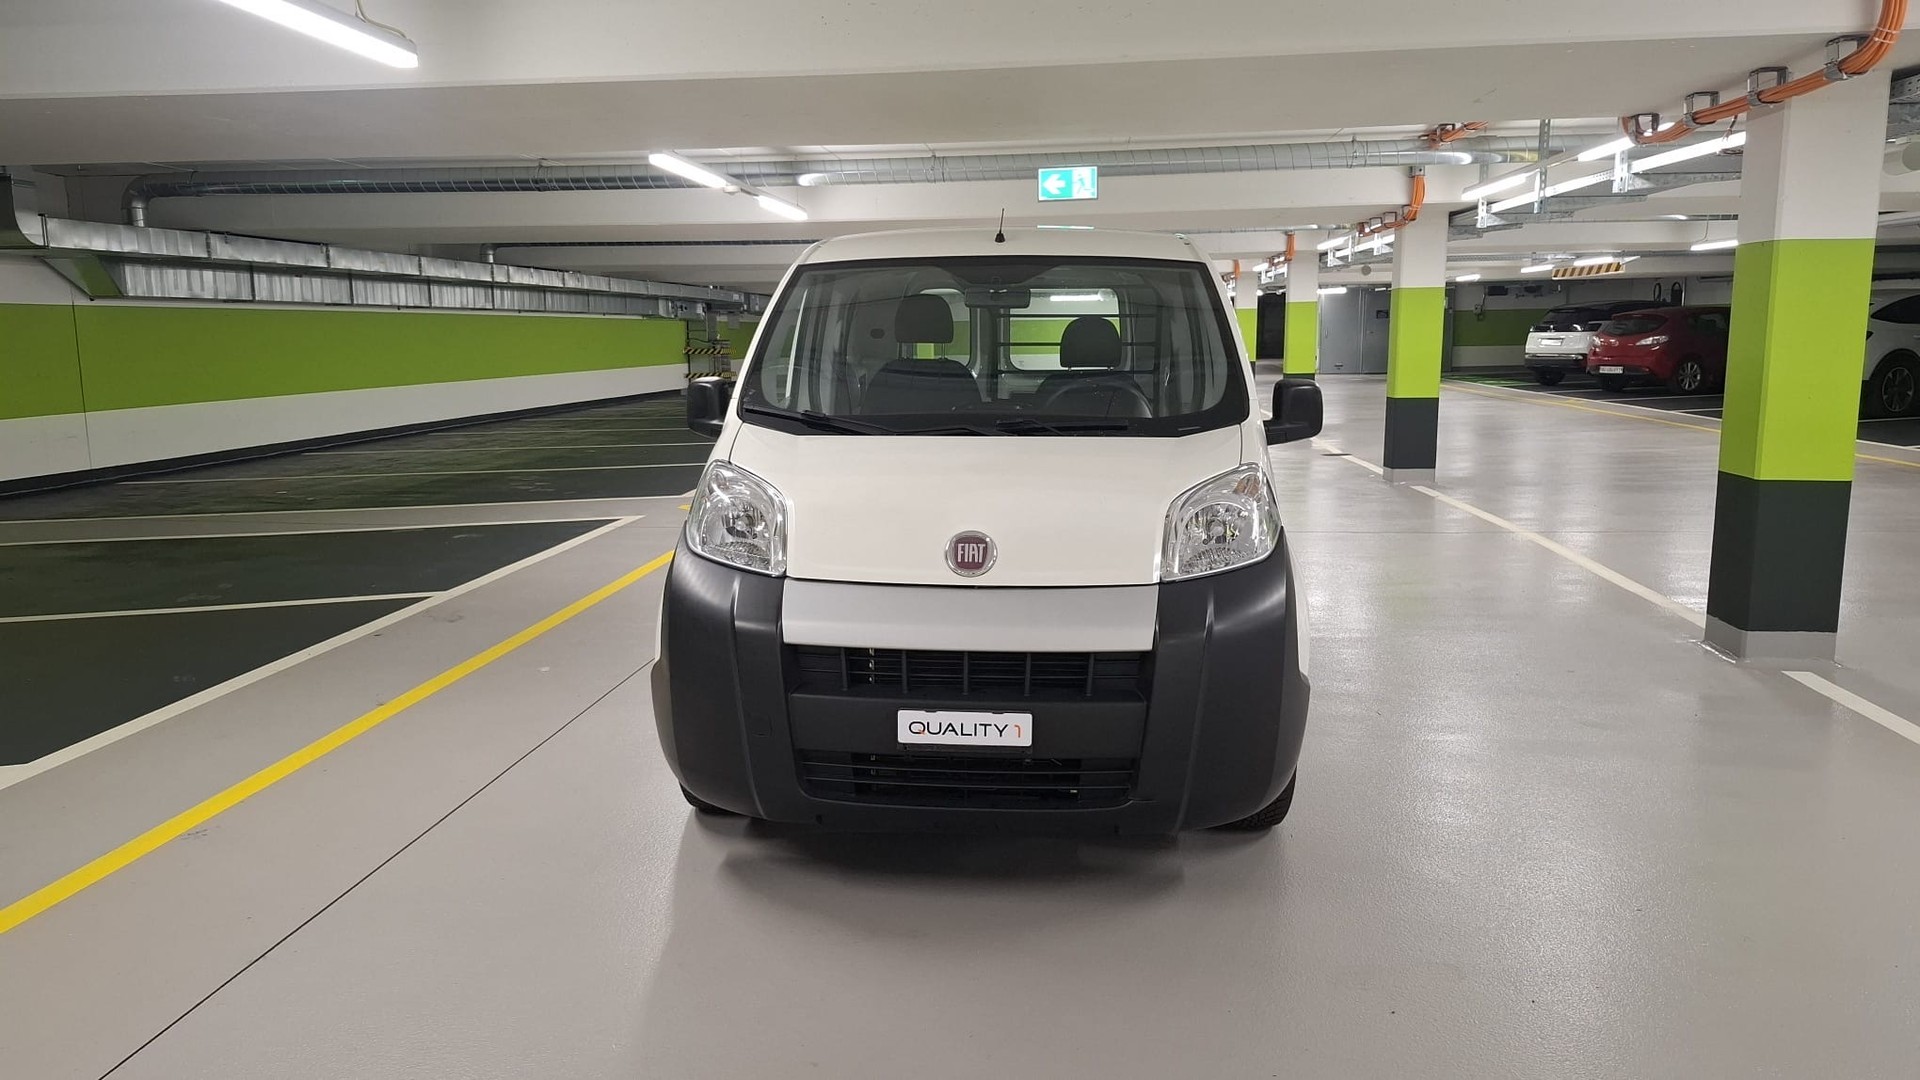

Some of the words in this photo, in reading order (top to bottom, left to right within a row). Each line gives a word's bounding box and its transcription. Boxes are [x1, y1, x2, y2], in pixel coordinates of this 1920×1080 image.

[957, 543, 986, 563] FIAT
[908, 721, 1009, 738] QUALITY
[1013, 724, 1021, 738] 1
